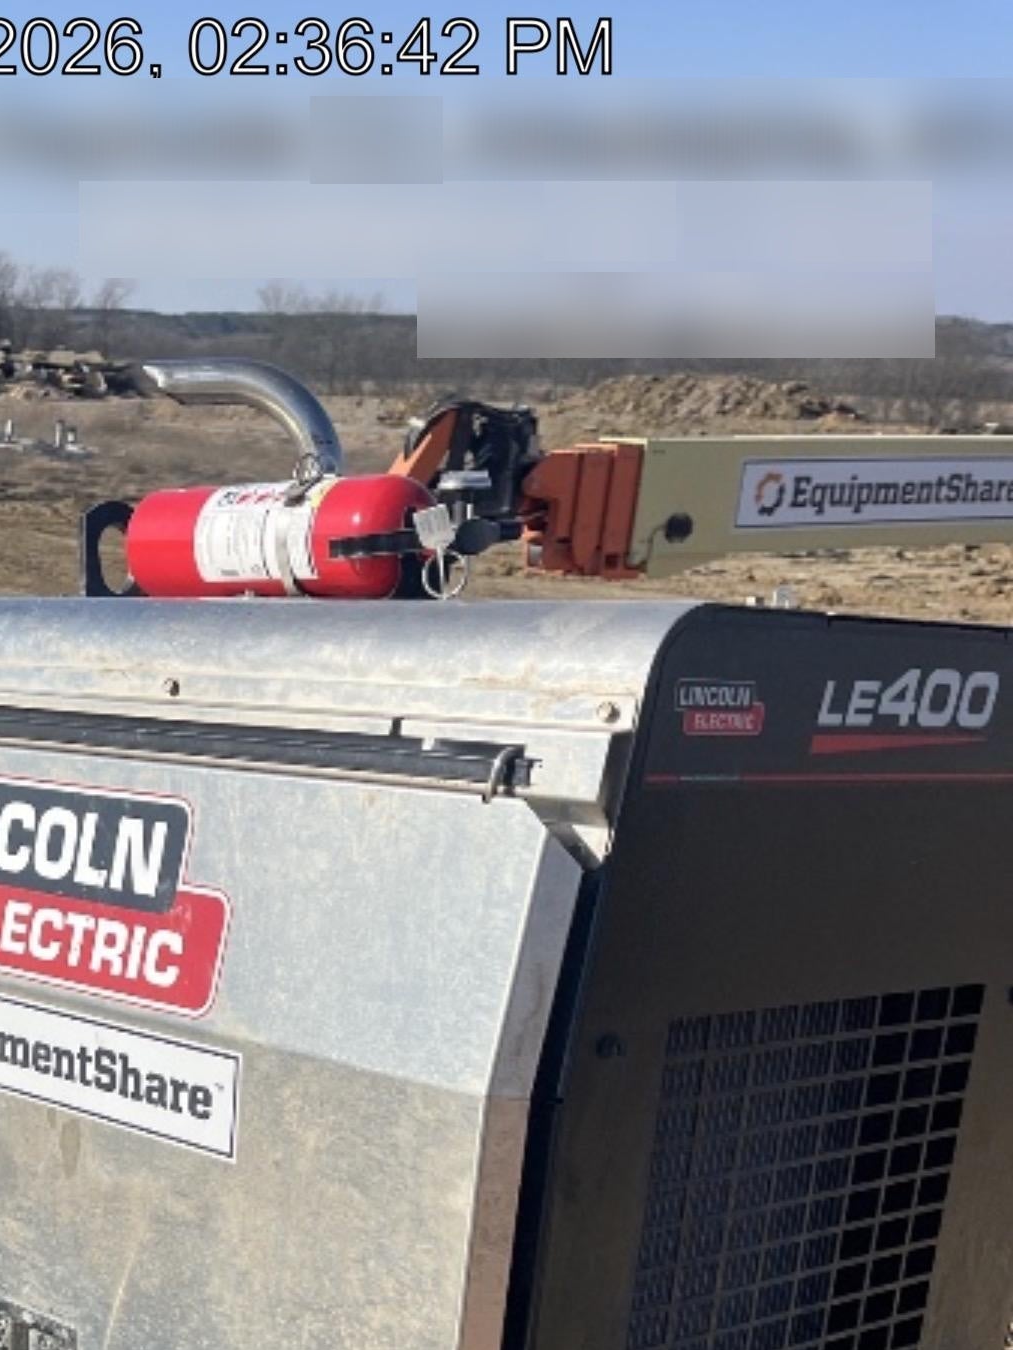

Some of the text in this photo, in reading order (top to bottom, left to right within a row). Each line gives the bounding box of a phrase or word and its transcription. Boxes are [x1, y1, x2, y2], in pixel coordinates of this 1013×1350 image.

[679, 686, 751, 707] LINCOLN
[818, 668, 1000, 728] LE400
[694, 713, 755, 731] ELECTRIC
